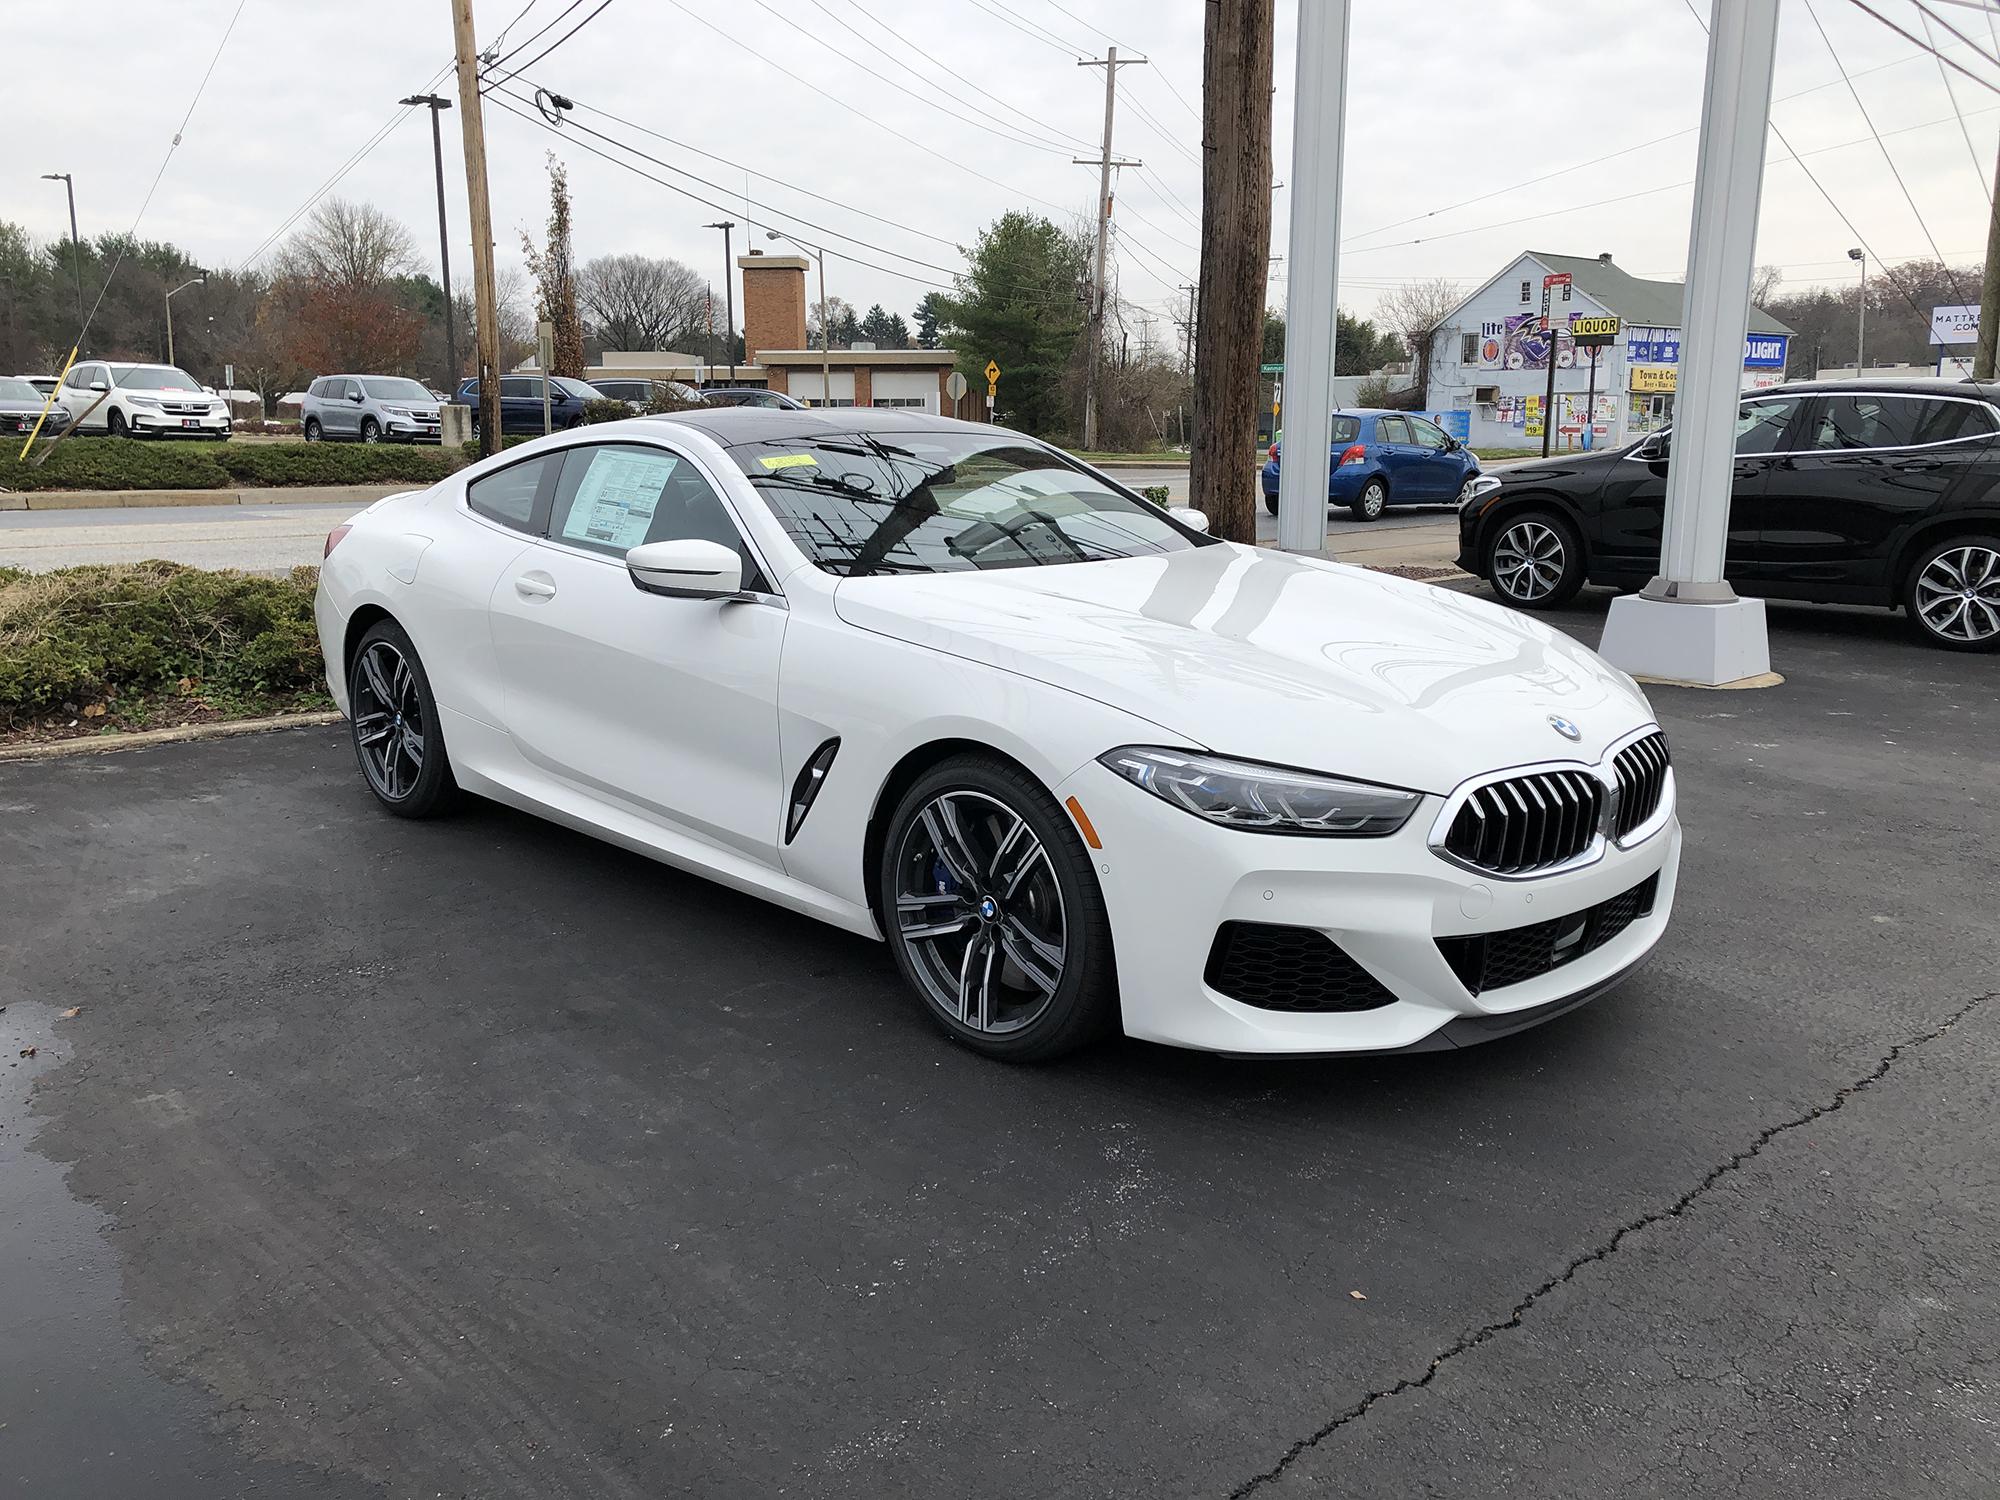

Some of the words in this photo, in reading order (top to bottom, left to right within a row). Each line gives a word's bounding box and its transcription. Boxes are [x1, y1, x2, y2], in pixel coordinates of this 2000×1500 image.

[1482, 322, 1503, 338] Lite
[1574, 320, 1616, 333] LIQUOR
[1628, 327, 1649, 342] TOWN
[1648, 328, 1665, 343] AND
[1751, 341, 1781, 359] LIGHT
[1640, 370, 1657, 379] Town
[1659, 370, 1664, 379] &
